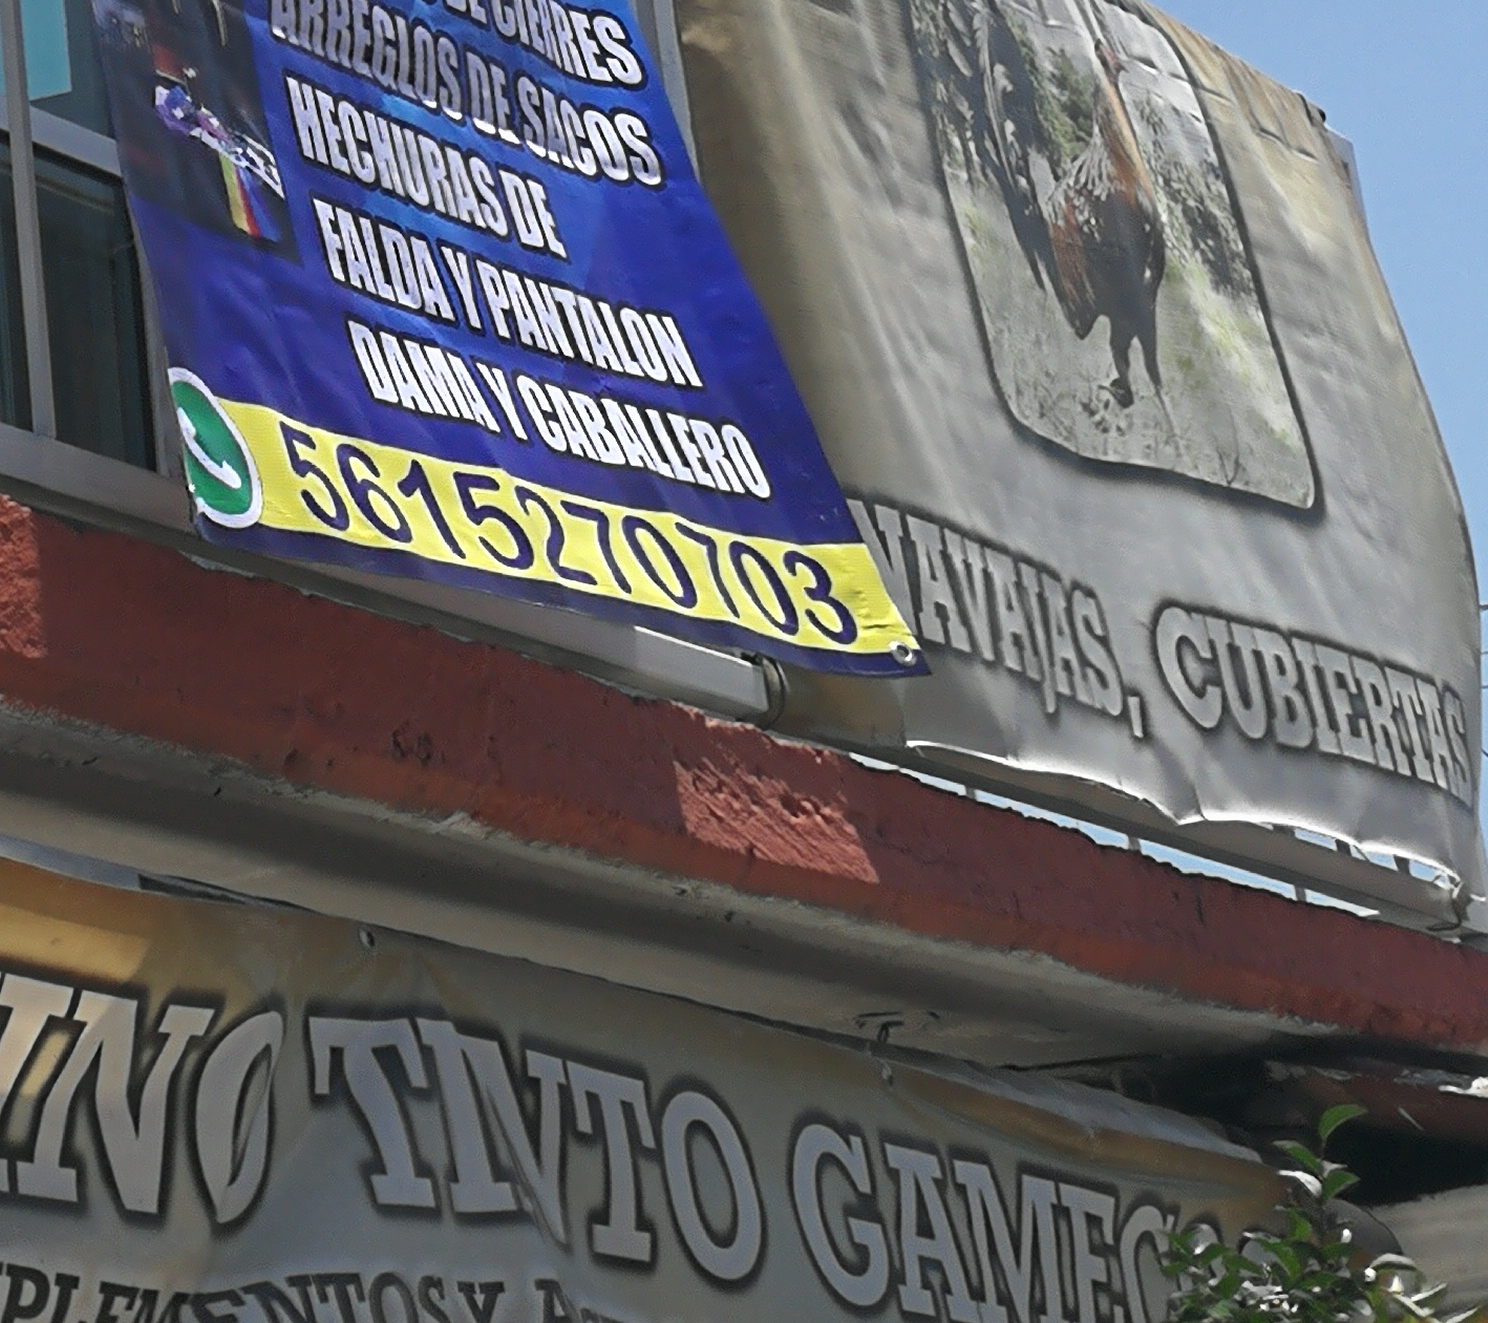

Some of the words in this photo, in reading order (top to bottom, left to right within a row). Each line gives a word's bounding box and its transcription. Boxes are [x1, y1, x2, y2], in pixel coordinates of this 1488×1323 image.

[285, 74, 510, 238] HECHURAS
[510, 170, 570, 260] DE
[468, 56, 518, 143] DE
[517, 77, 665, 188] SACOS
[311, 195, 457, 324] FALDA
[443, 247, 484, 333] Y
[476, 263, 704, 390] PANTALON
[348, 319, 502, 435] DAMA
[489, 367, 531, 445] Y
[515, 376, 774, 500] CABALLERO
[281, 423, 859, 647] 5615270703
[1156, 606, 1472, 806] CUBIERTAS
[309, 1015, 764, 1282] TINTO
